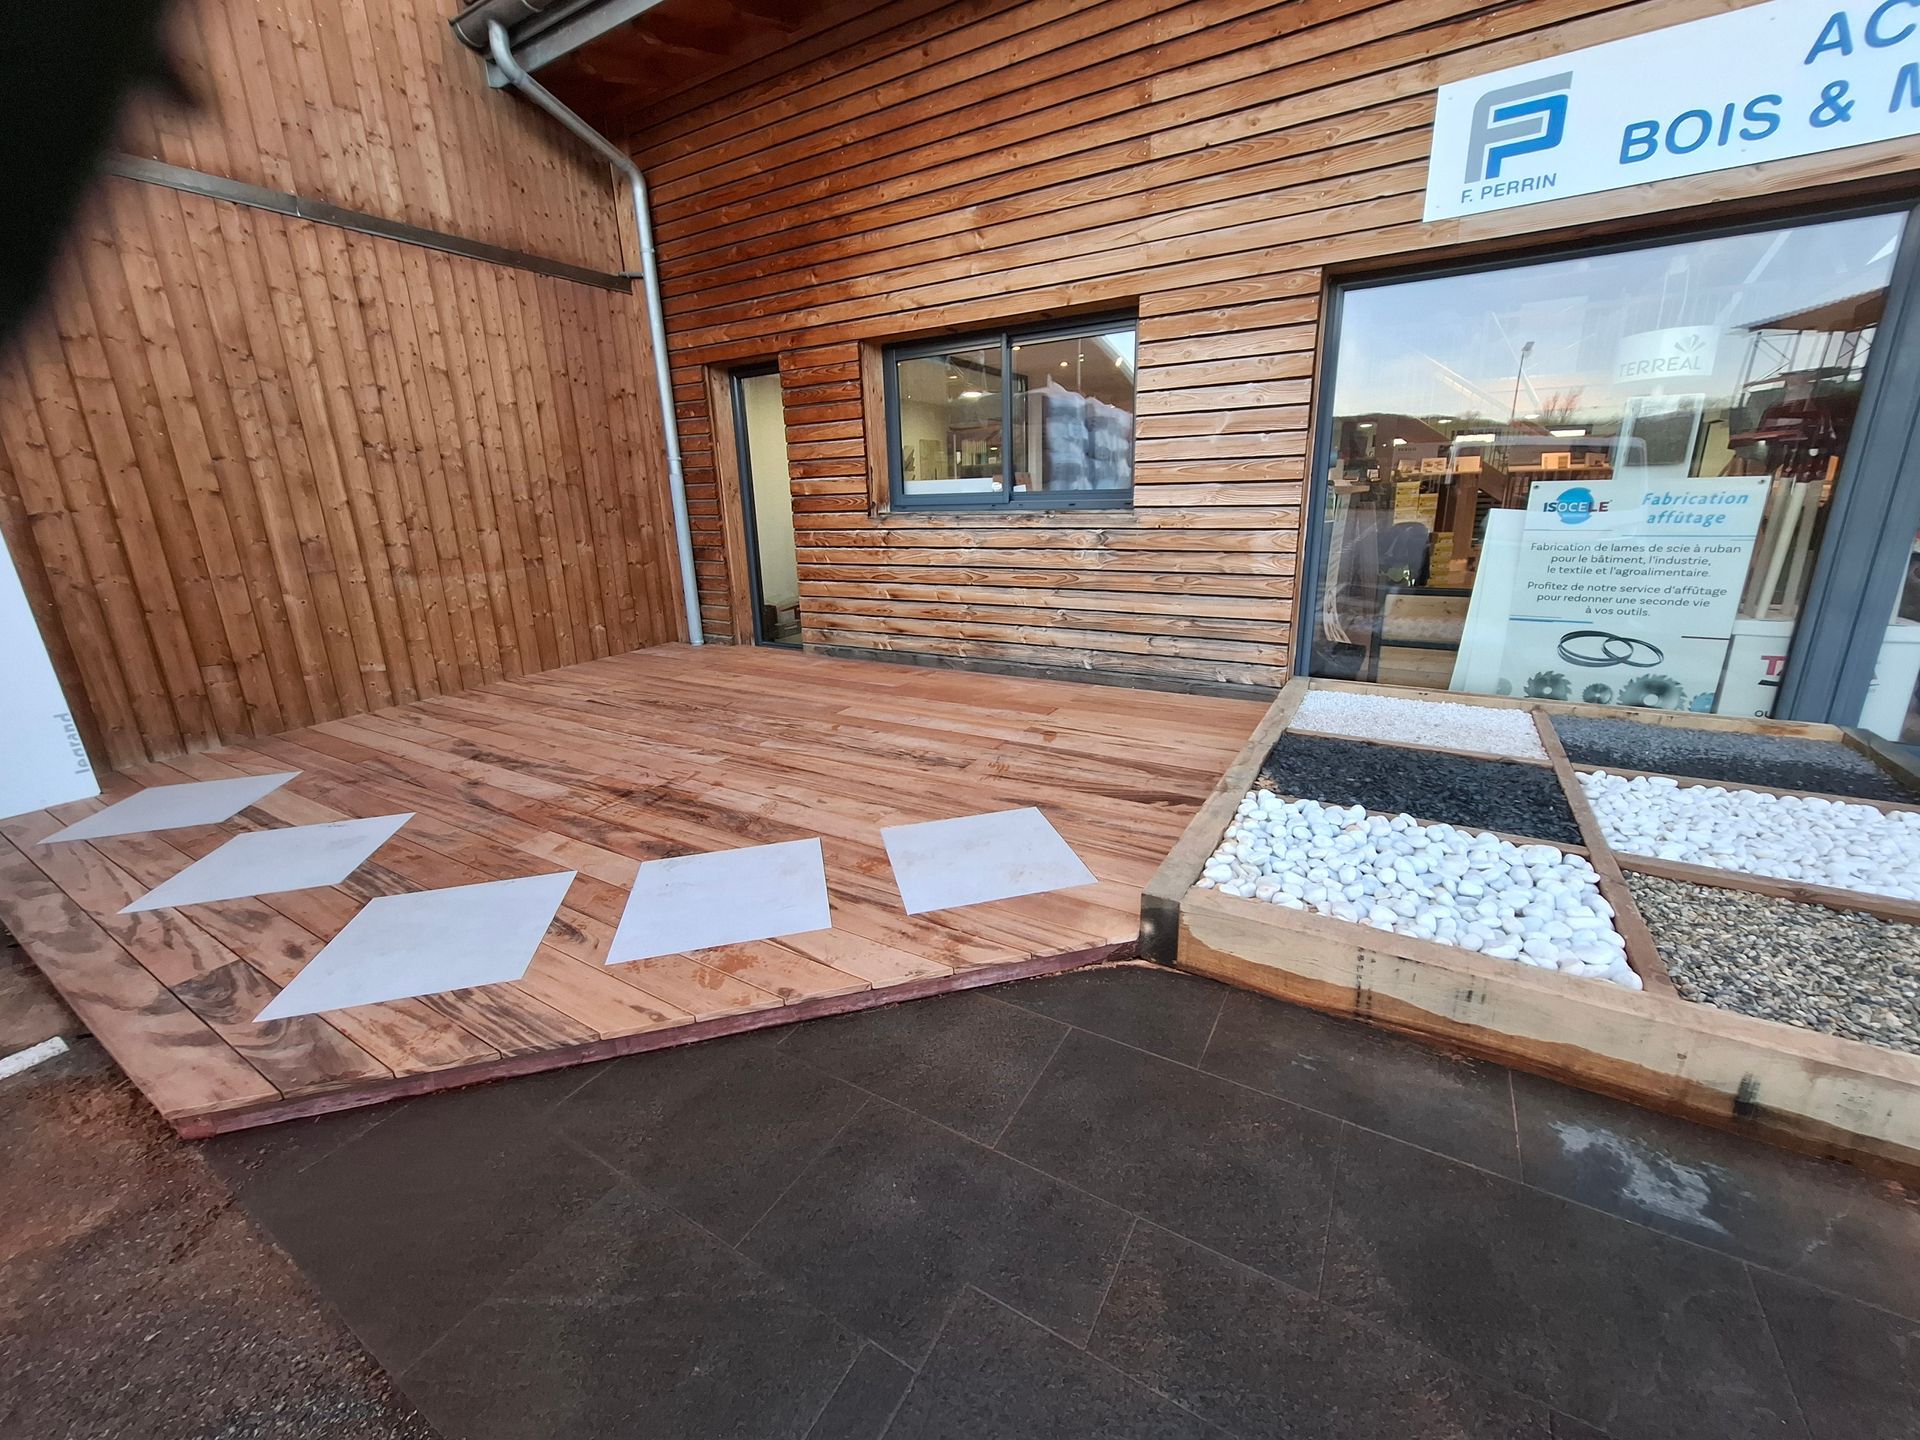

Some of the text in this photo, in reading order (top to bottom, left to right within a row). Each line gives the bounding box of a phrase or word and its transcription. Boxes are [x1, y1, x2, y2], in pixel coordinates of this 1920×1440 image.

[1619, 94, 1783, 164] BOIS
[1809, 80, 1855, 128] &
[1461, 173, 1557, 203] F. PERRIN
[1619, 356, 1702, 377] TERREAL
[1641, 490, 1750, 506] Fabrication
[1646, 509, 1727, 528] affûtage
[1530, 542, 1742, 554] Fabrication de lames de scie à ruban
[1550, 554, 1712, 567] pour le bâtiment, l'industrie,
[1546, 565, 1712, 578] le textile et l'agroalimentaire.
[1527, 580, 1728, 598] Profitez de notre service d'affûtage
[1536, 594, 1711, 608] pour redonner une seconde vie
[1585, 605, 1651, 617] à vos outils.
